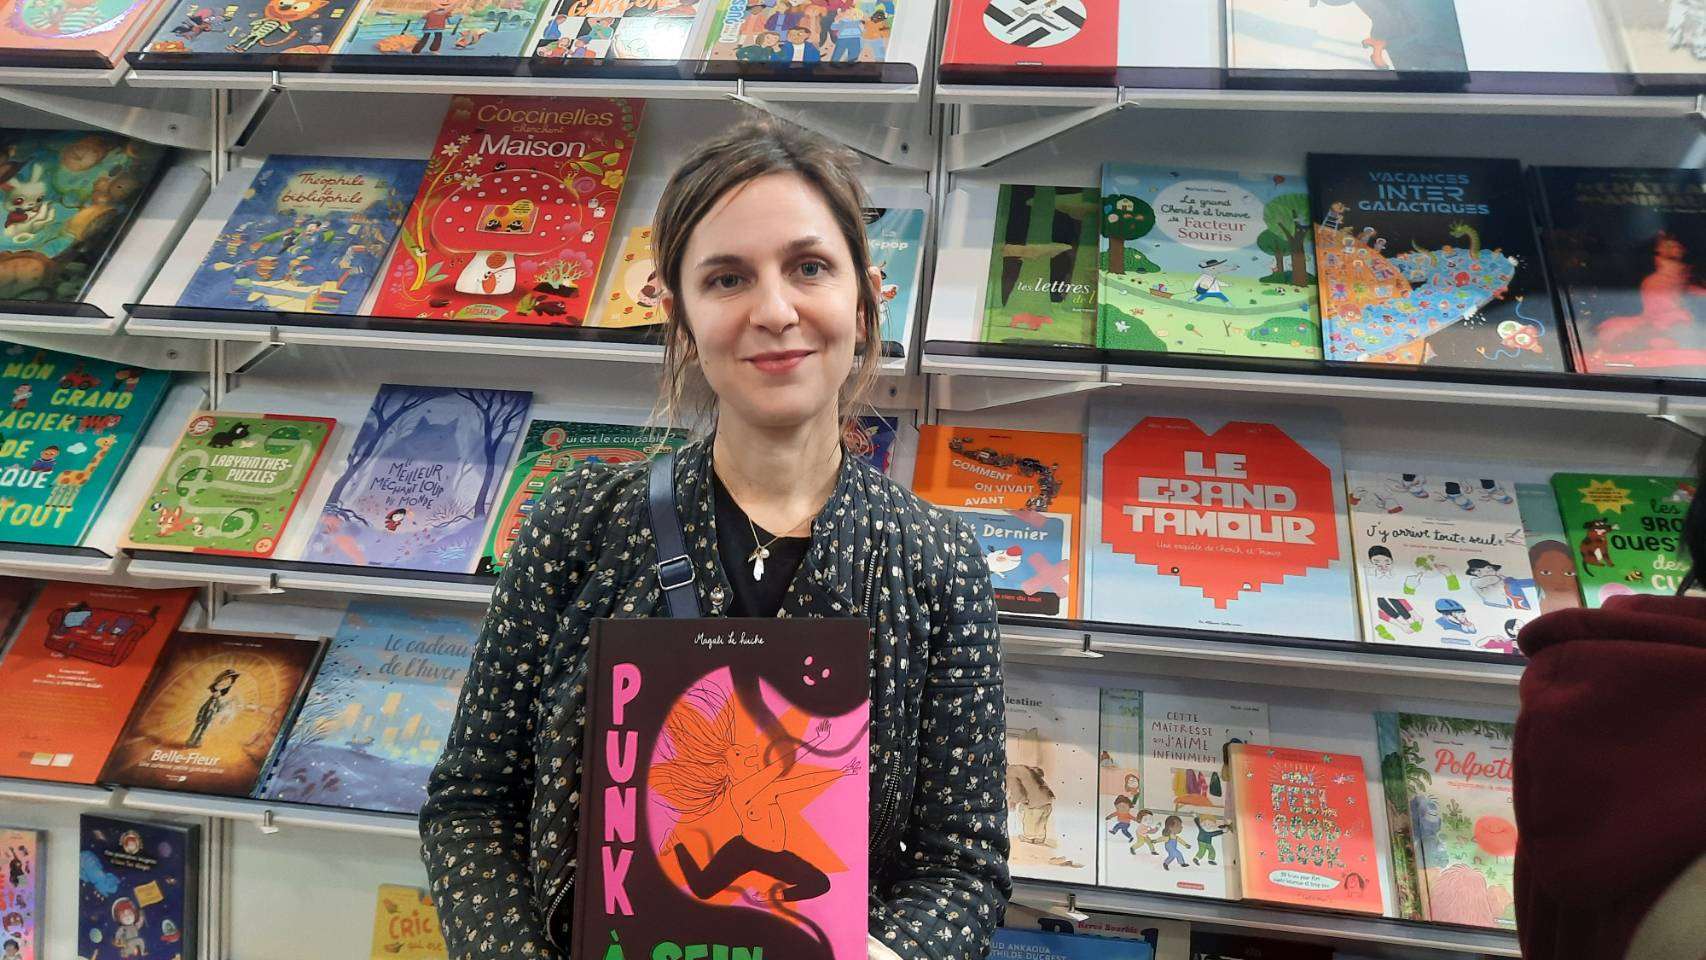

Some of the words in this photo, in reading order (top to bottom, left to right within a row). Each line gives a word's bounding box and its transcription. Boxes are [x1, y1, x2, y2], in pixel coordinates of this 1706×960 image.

[478, 104, 614, 126] Coccinelles
[478, 133, 586, 158] Maison
[1369, 172, 1469, 185] VACANCES
[1378, 184, 1464, 201] INTER
[1200, 199, 1231, 208] grand
[1359, 200, 1490, 214] GALACTIQUES
[1184, 216, 1246, 231] Facteur
[1178, 228, 1232, 241] Souris
[1034, 277, 1090, 294] lettres
[2, 362, 56, 380] MON
[50, 388, 134, 409] GRAND
[0, 409, 77, 432] AGIER
[0, 439, 34, 459] DE
[580, 435, 597, 444] est
[600, 433, 613, 444] le
[615, 434, 668, 447] coupable
[388, 462, 444, 485] MEILLEUR
[952, 459, 1013, 482] COMMENT
[1184, 451, 1248, 479] LE
[0, 469, 52, 489] QUE
[225, 469, 278, 484] PUZZLES
[974, 482, 993, 493] ON
[995, 485, 1035, 494] VIVAIT
[1138, 476, 1298, 513] GRAND
[964, 496, 1006, 507] AVANT
[0, 498, 73, 529] TOUT
[982, 523, 1049, 541] Dernier
[1122, 505, 1317, 545] TAMOUR
[1366, 521, 1389, 544] J'y
[1392, 525, 1430, 539] arrive
[1433, 529, 1465, 543] toute
[384, 633, 401, 652] Le
[405, 634, 468, 658] cadeau
[694, 631, 724, 650] Magali
[380, 654, 401, 675] de
[1166, 711, 1200, 723] CETTE
[1165, 734, 1208, 751] J'AIME
[150, 749, 220, 766] Belle-Fleur
[1153, 749, 1216, 764] INFINIMENT
[601, 662, 643, 917] PUNK
